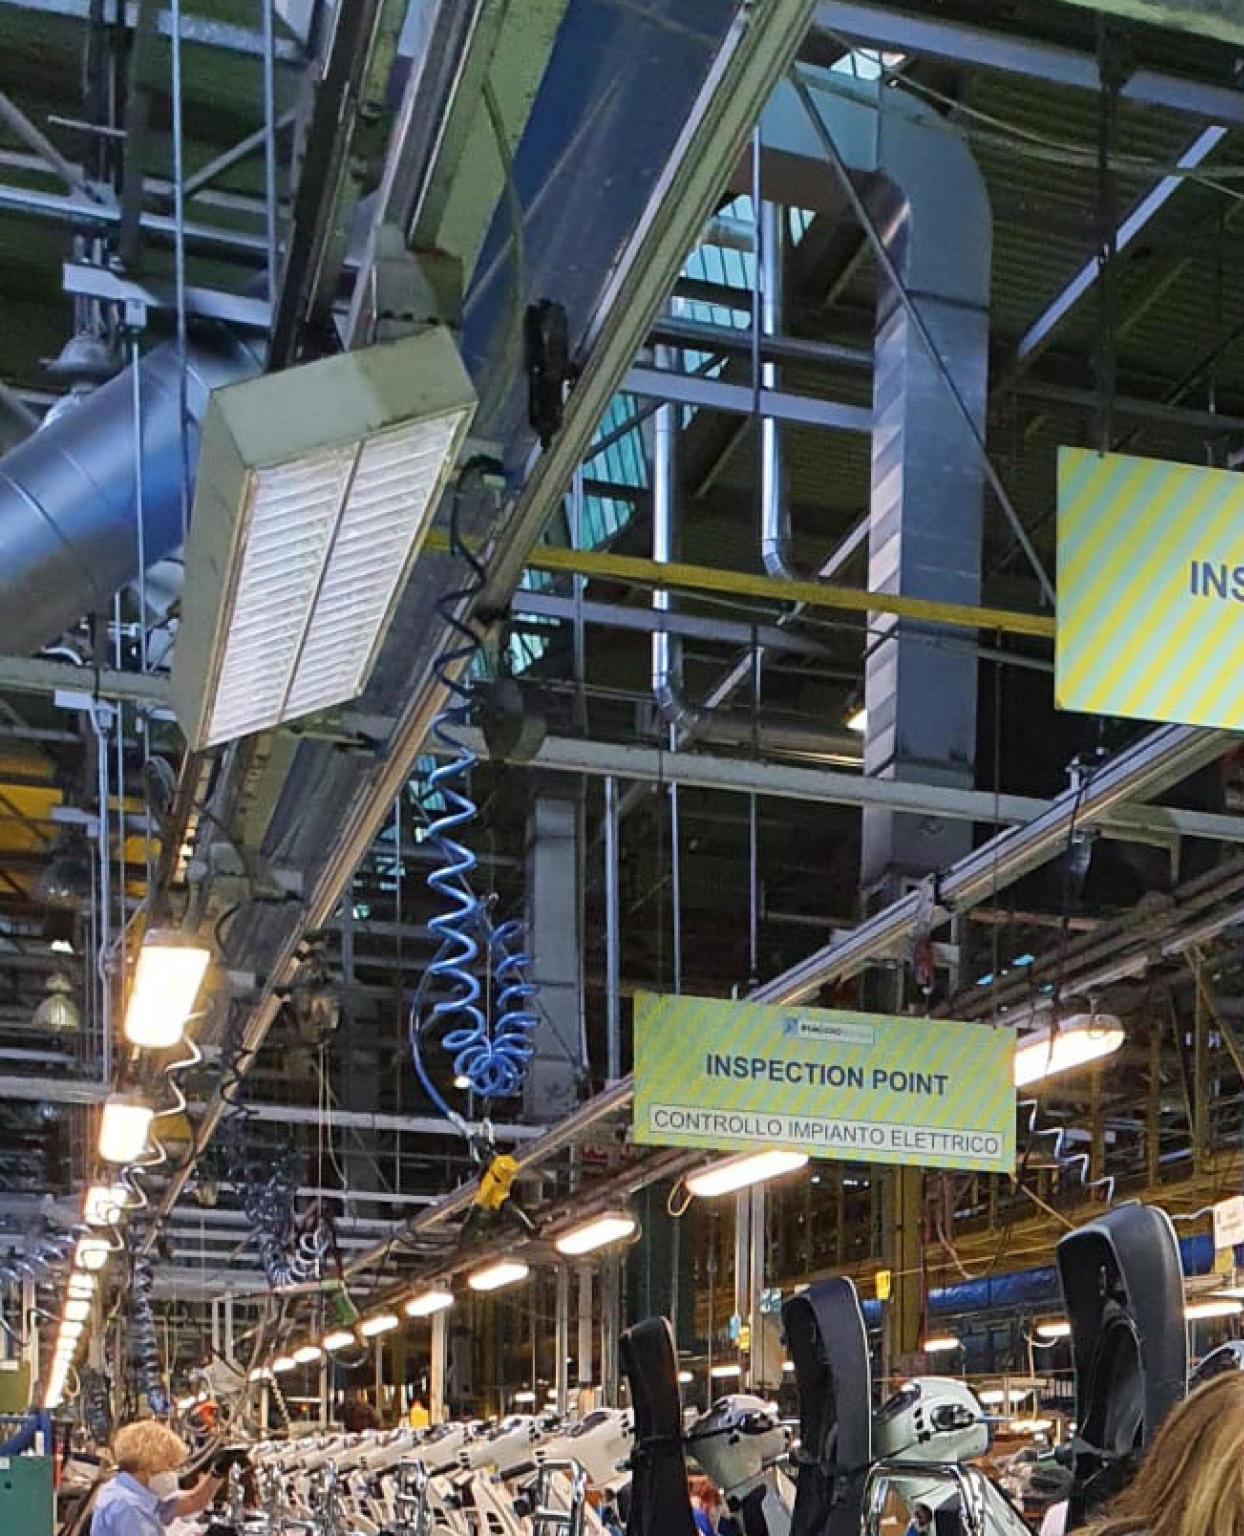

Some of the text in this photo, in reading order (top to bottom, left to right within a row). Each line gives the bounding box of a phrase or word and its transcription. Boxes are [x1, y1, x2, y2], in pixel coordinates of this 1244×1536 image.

[705, 1053, 949, 1096] INSPECTION POINT
[653, 1109, 1000, 1155] CONTROLLO IMPIANTO ELETTRICO
